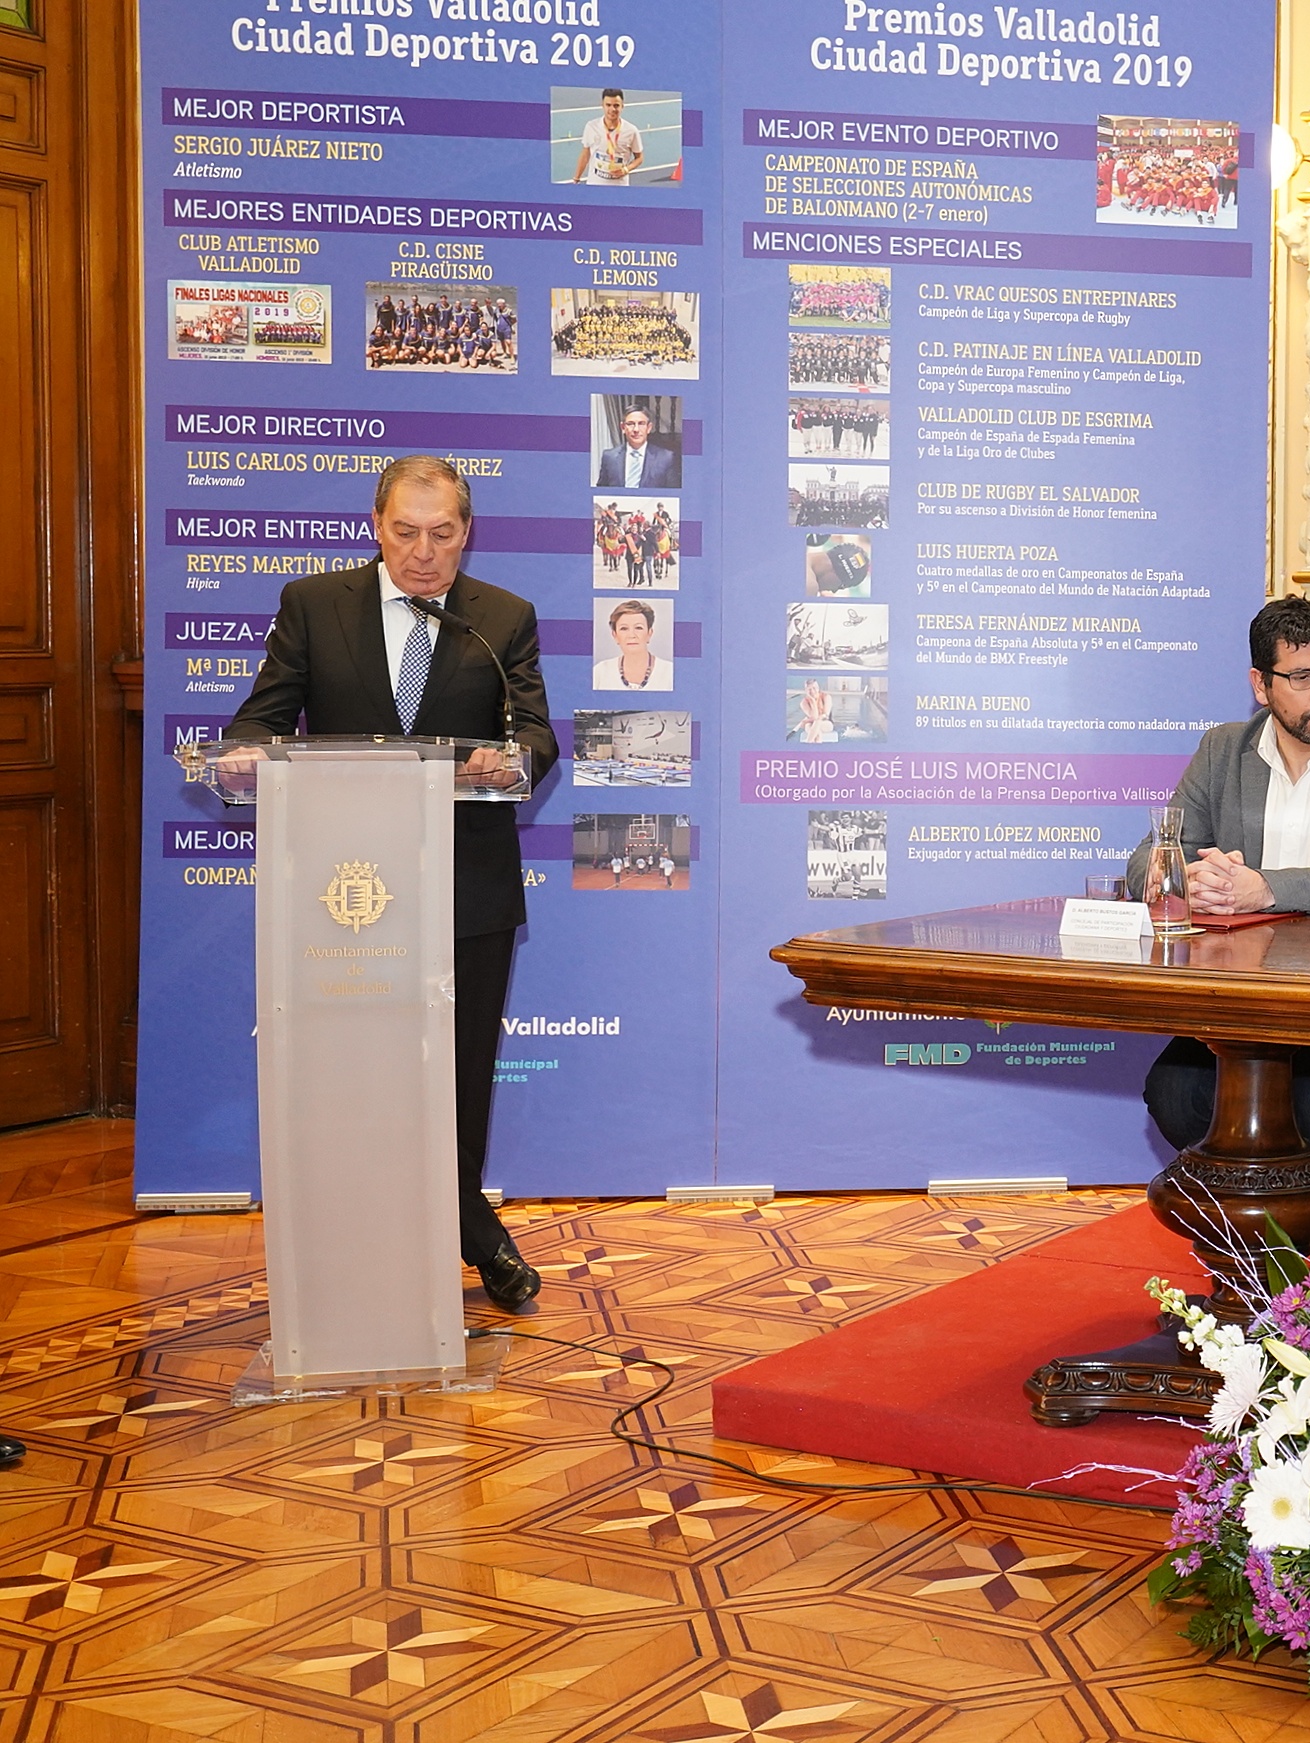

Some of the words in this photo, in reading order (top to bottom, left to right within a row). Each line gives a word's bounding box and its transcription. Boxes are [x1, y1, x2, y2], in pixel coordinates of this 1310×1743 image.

[428, 0, 600, 27] Valladolid
[844, 0, 984, 38] Premios
[994, 6, 1160, 47] Valladolid
[232, 17, 354, 56] Ciudad
[365, 23, 539, 64] Deportiva
[550, 32, 634, 68] 2019
[811, 37, 927, 74] Ciudad
[937, 43, 1102, 83] Deportiva
[1112, 52, 1192, 88] 2019
[174, 97, 254, 120] MEJOR
[262, 101, 405, 126] DEPORTISTA
[759, 118, 834, 140] MEJOR
[842, 122, 928, 144] EVENTO
[937, 126, 1058, 150] DEPORTIVO
[174, 135, 242, 156] SERGIO
[247, 136, 320, 159] JUÁREZ
[326, 141, 382, 161] NIETO
[173, 161, 242, 179] Atletismo
[766, 154, 880, 175] CAMPEONATO
[884, 159, 906, 176] DE
[911, 159, 979, 179] ESPAÑA
[765, 175, 787, 193] DE
[792, 176, 906, 198] SELECCIONES
[910, 180, 1032, 203] AUTONÓMICAS
[174, 198, 284, 221] MEJORES
[292, 203, 422, 226] ENTIDADES
[430, 208, 572, 232] DEPORTIVAS
[765, 197, 787, 214] DE
[792, 198, 898, 219] BALONMANO
[903, 202, 934, 223] (2-7
[939, 205, 988, 226] enero)
[179, 234, 222, 251] CLUB
[226, 236, 319, 254] ATLETISMO
[399, 241, 430, 259] C.D.
[436, 243, 484, 262] CISNE
[753, 231, 882, 254] MENCIONES
[890, 236, 1022, 260] ESPECIALES
[198, 255, 300, 274] VALLADOLID
[574, 248, 605, 265] C.D.
[610, 249, 677, 267] ROLLING
[391, 261, 492, 281] PIRAGÜISMO
[593, 269, 658, 287] LEMONS
[175, 287, 210, 301] FINALES
[212, 288, 236, 302] LIGAS
[238, 289, 289, 304] NACIONALES
[919, 283, 949, 300] C.D.
[954, 285, 994, 301] VRAC
[999, 286, 1058, 304] QUESOS
[1062, 289, 1176, 309] ENTREPINARES
[919, 341, 948, 358] C.D.
[953, 342, 1028, 360] PATINAJE
[1032, 345, 1052, 361] EN
[1057, 344, 1104, 363] LÍNEA
[1108, 348, 1201, 366] VALLADOLID
[178, 414, 256, 435] MEJOR
[265, 416, 385, 438] DIRECTIVO
[918, 406, 1014, 424] VALLADOLID
[1018, 409, 1057, 426] CLUB
[1061, 411, 1081, 426] DE
[1085, 411, 1154, 429] ESGRIMA
[187, 451, 230, 470] LUIS
[236, 452, 307, 472] CARLOS
[188, 474, 245, 487] Taekwondo
[918, 482, 957, 499] CLUB
[962, 484, 981, 499] DE
[986, 484, 1036, 500] RUGBY
[1040, 486, 1058, 501] EL
[1062, 486, 1140, 503] SALVADOR
[178, 517, 256, 538] MEJOR
[265, 518, 378, 540] ENTRENA
[917, 543, 952, 559] LUIS
[956, 544, 1016, 560] HUERTA
[1020, 546, 1059, 561] POZA
[187, 554, 246, 573] REYES
[252, 552, 326, 575] MARTÍN
[186, 577, 220, 592] Hípica
[916, 614, 974, 630] TERESA
[979, 614, 1068, 632] FERNÁNDEZ
[1072, 617, 1142, 633] MIRANDA
[217, 658, 253, 677] DEL
[185, 681, 235, 693] Atletismo
[916, 695, 978, 711] MARINA
[982, 696, 1030, 711] BUENO
[916, 715, 929, 727] 89
[932, 716, 967, 728] títulos
[970, 719, 983, 728] en
[986, 719, 998, 728] su
[1001, 716, 1044, 729] dilatada
[1047, 718, 1105, 732] trayectoria
[1108, 721, 1136, 730] como
[1138, 718, 1186, 730] nadadora
[756, 760, 838, 778] PREMIO
[846, 757, 903, 779] JOSÉ
[911, 761, 958, 779] LUIS
[966, 761, 1077, 780] MORENCIA
[755, 784, 827, 801] (Otorgado
[832, 788, 856, 802] por
[860, 785, 872, 799] la
[876, 785, 954, 799] Asociación
[959, 786, 976, 799] de
[981, 786, 992, 799] la
[998, 786, 1046, 800] Prensa
[1051, 787, 1117, 803] Deportiva
[175, 830, 254, 850] MEJOR
[908, 826, 980, 842] ALBERTO
[984, 824, 1033, 842] LÓPEZ
[1037, 827, 1100, 842] MORENO
[908, 847, 962, 862] Exjugador
[964, 850, 972, 862] y
[974, 847, 1007, 859] actual
[1010, 847, 1048, 859] médico
[1051, 847, 1066, 860] del
[1070, 848, 1092, 860] Real
[304, 945, 407, 961] Ayuntamiento
[347, 963, 364, 976] de
[320, 982, 391, 996] Valladolid
[501, 1016, 620, 1036] Valladolid
[884, 1043, 972, 1066] FMD
[976, 1043, 1046, 1052] Fundación
[1050, 1042, 1115, 1053] Municipal
[1005, 1056, 1021, 1065] de
[1025, 1056, 1087, 1066] Deportes
